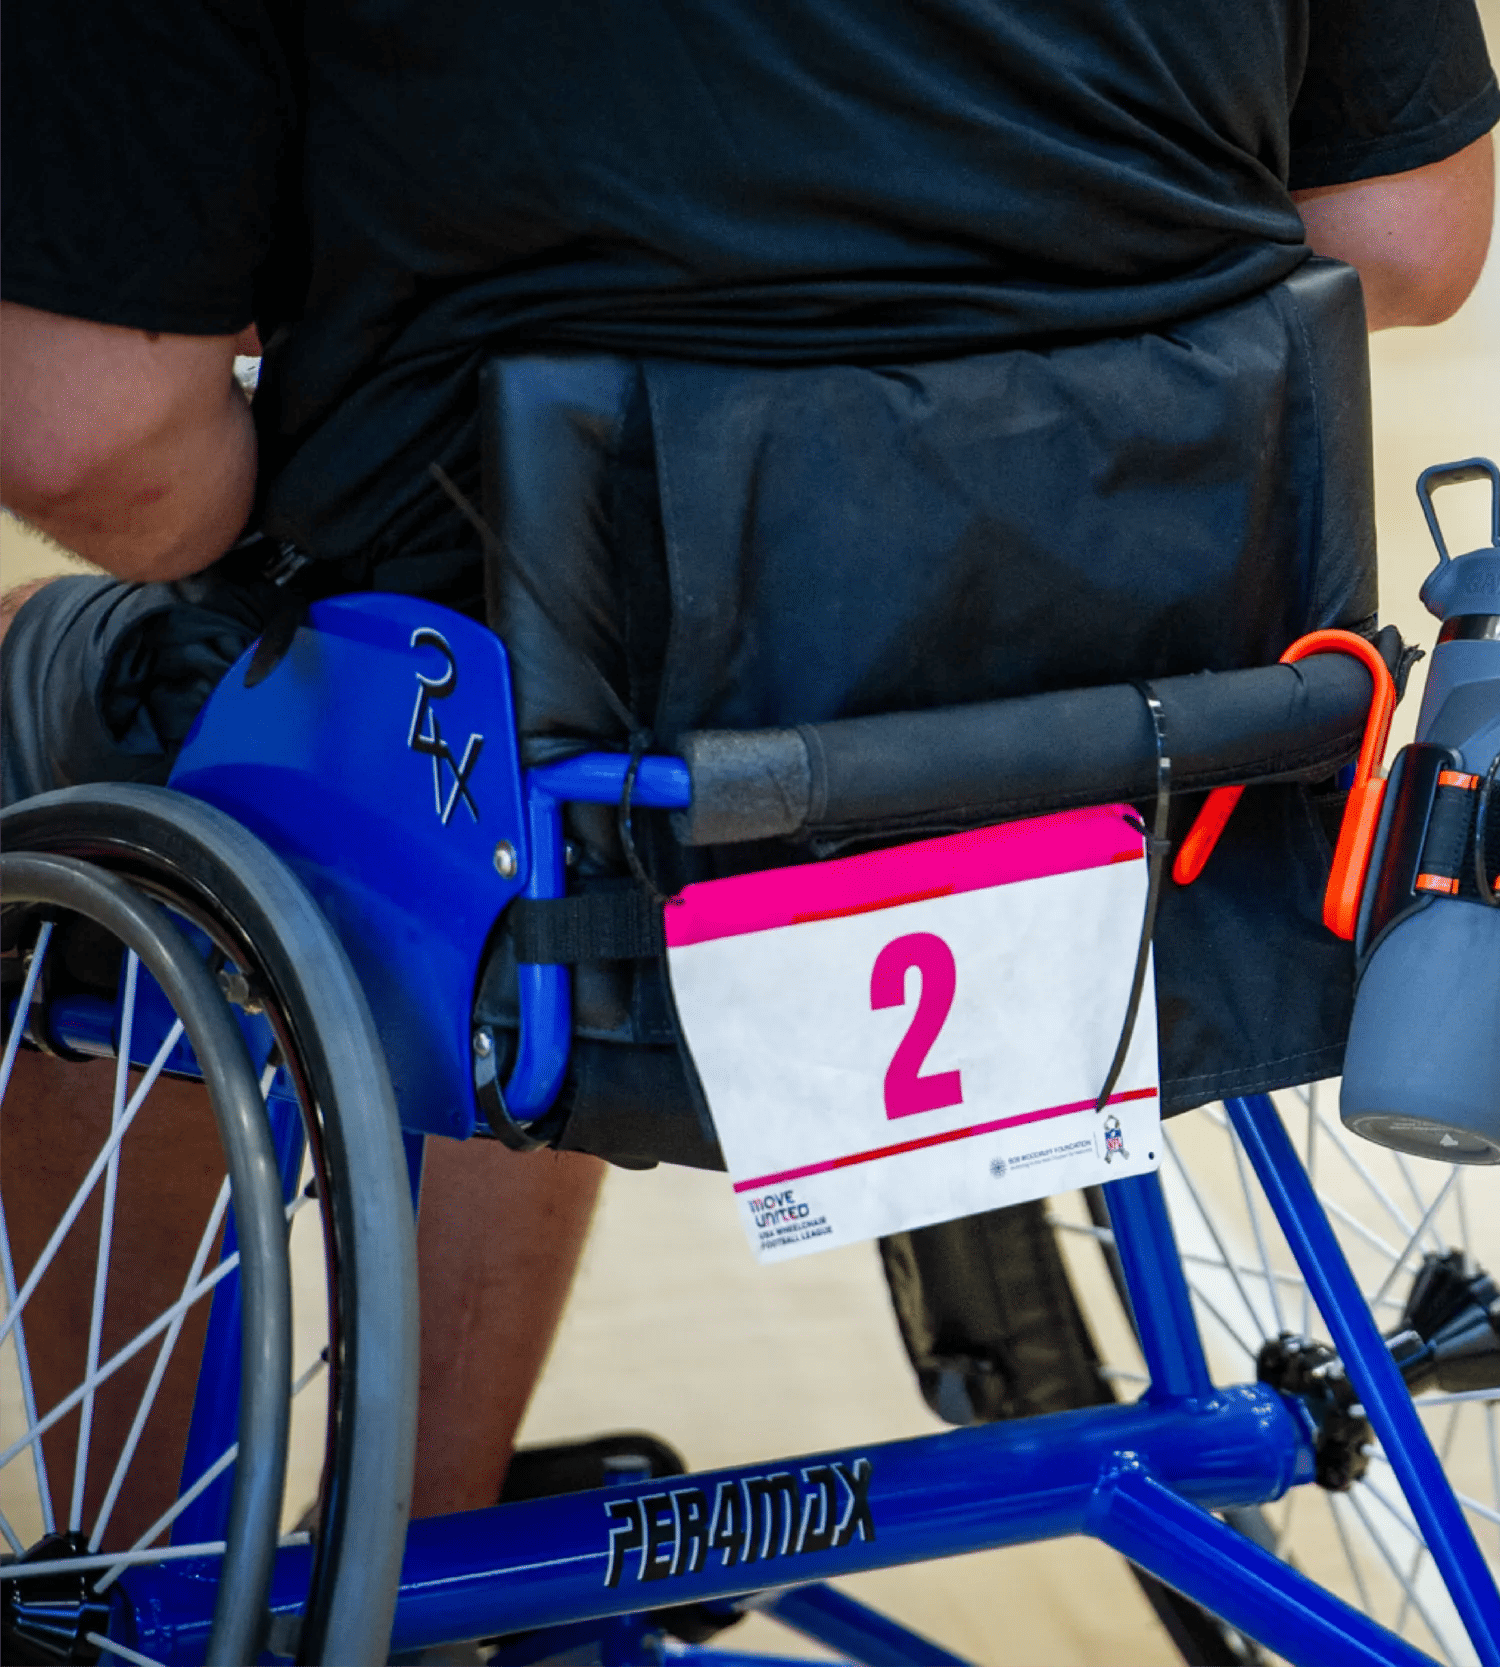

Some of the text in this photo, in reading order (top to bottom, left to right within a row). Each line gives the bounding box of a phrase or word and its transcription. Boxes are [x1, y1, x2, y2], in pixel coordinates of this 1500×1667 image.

[870, 931, 964, 1121] 2
[748, 1190, 795, 1213] MOVE
[755, 1203, 810, 1228] UNITED
[603, 1457, 876, 1588] PER4MAX
